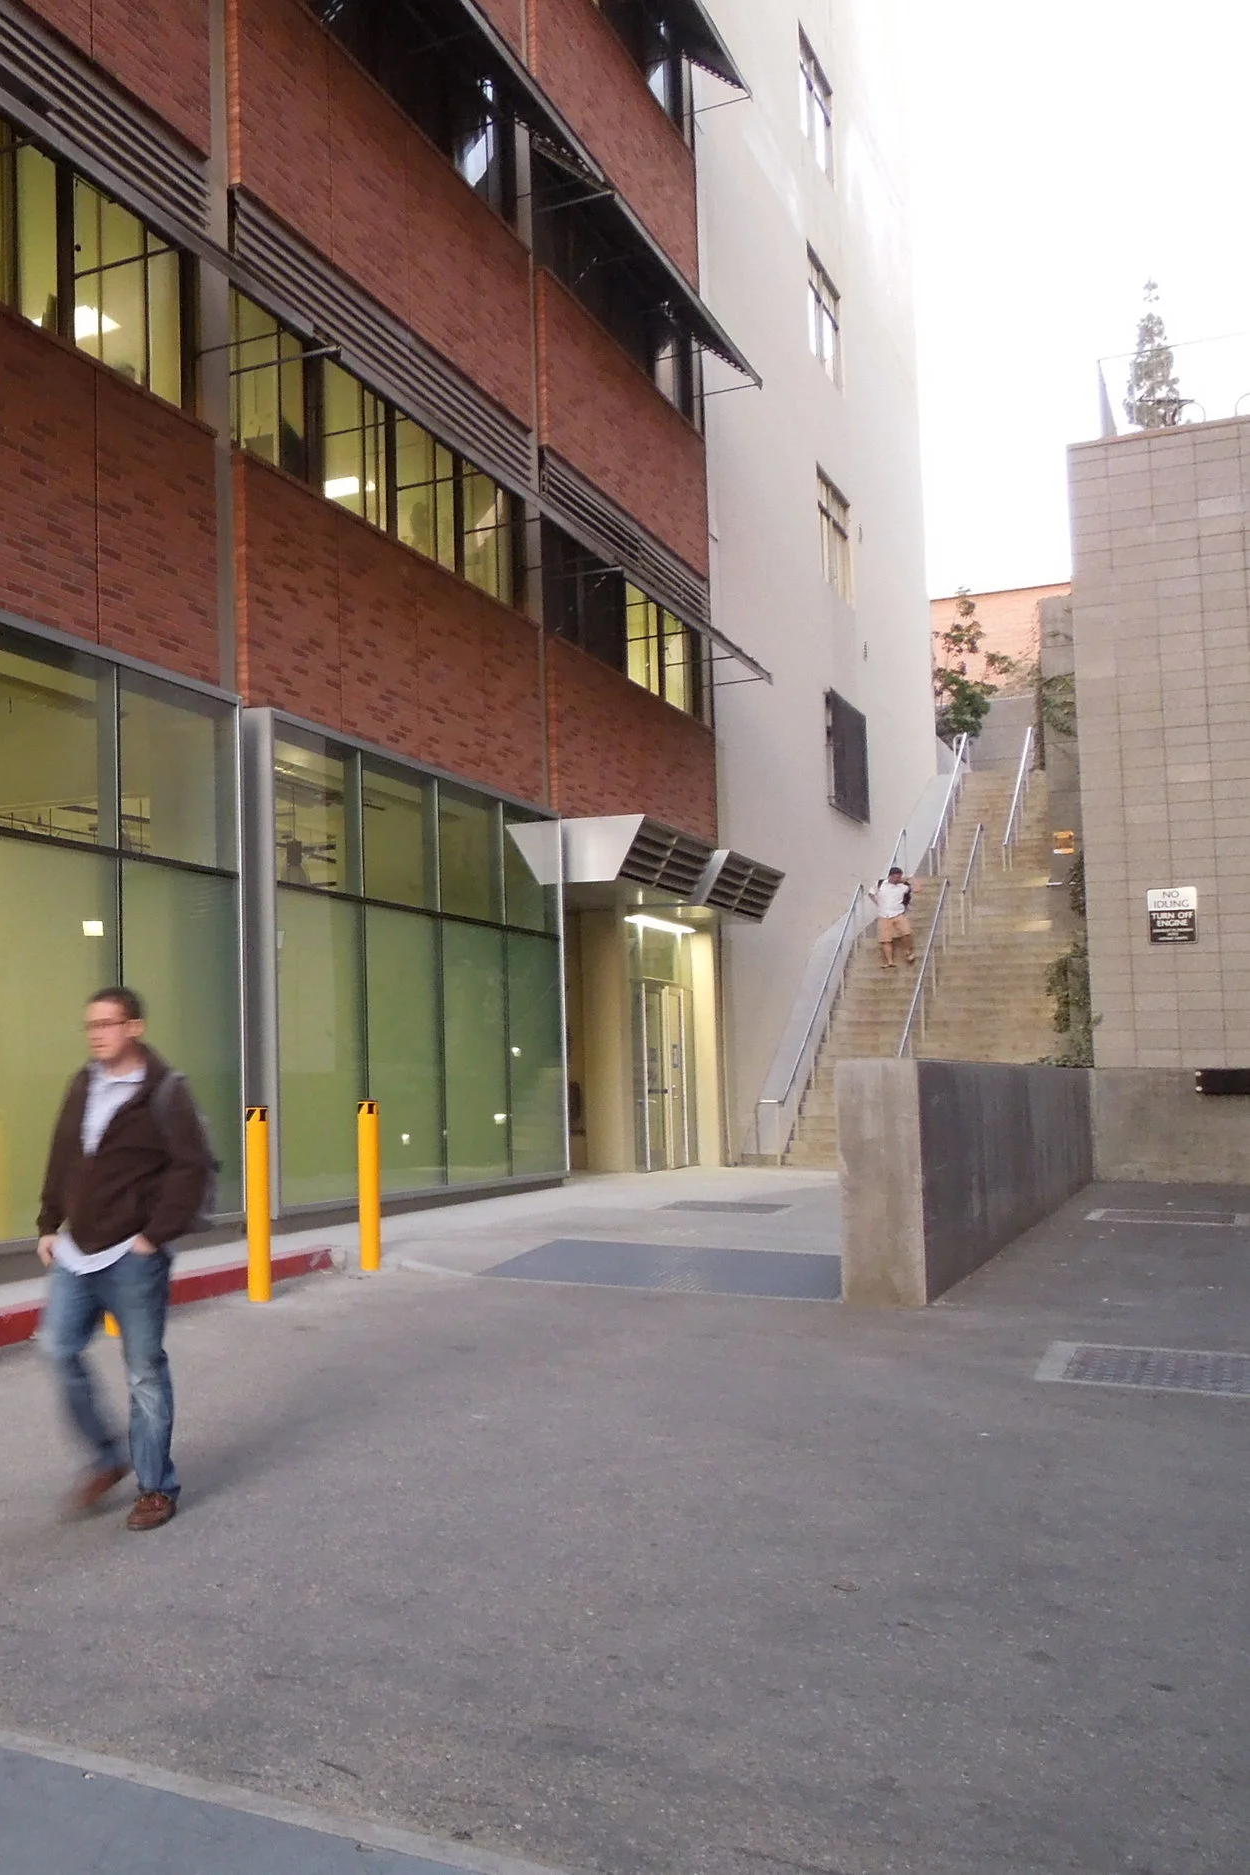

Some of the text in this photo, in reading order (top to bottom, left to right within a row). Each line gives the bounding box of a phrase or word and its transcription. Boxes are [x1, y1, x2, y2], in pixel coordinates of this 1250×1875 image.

[1162, 890, 1180, 898] NO
[1153, 899, 1190, 908] IDLING
[1177, 911, 1193, 919] OFF
[1157, 919, 1189, 927] ENGINE
